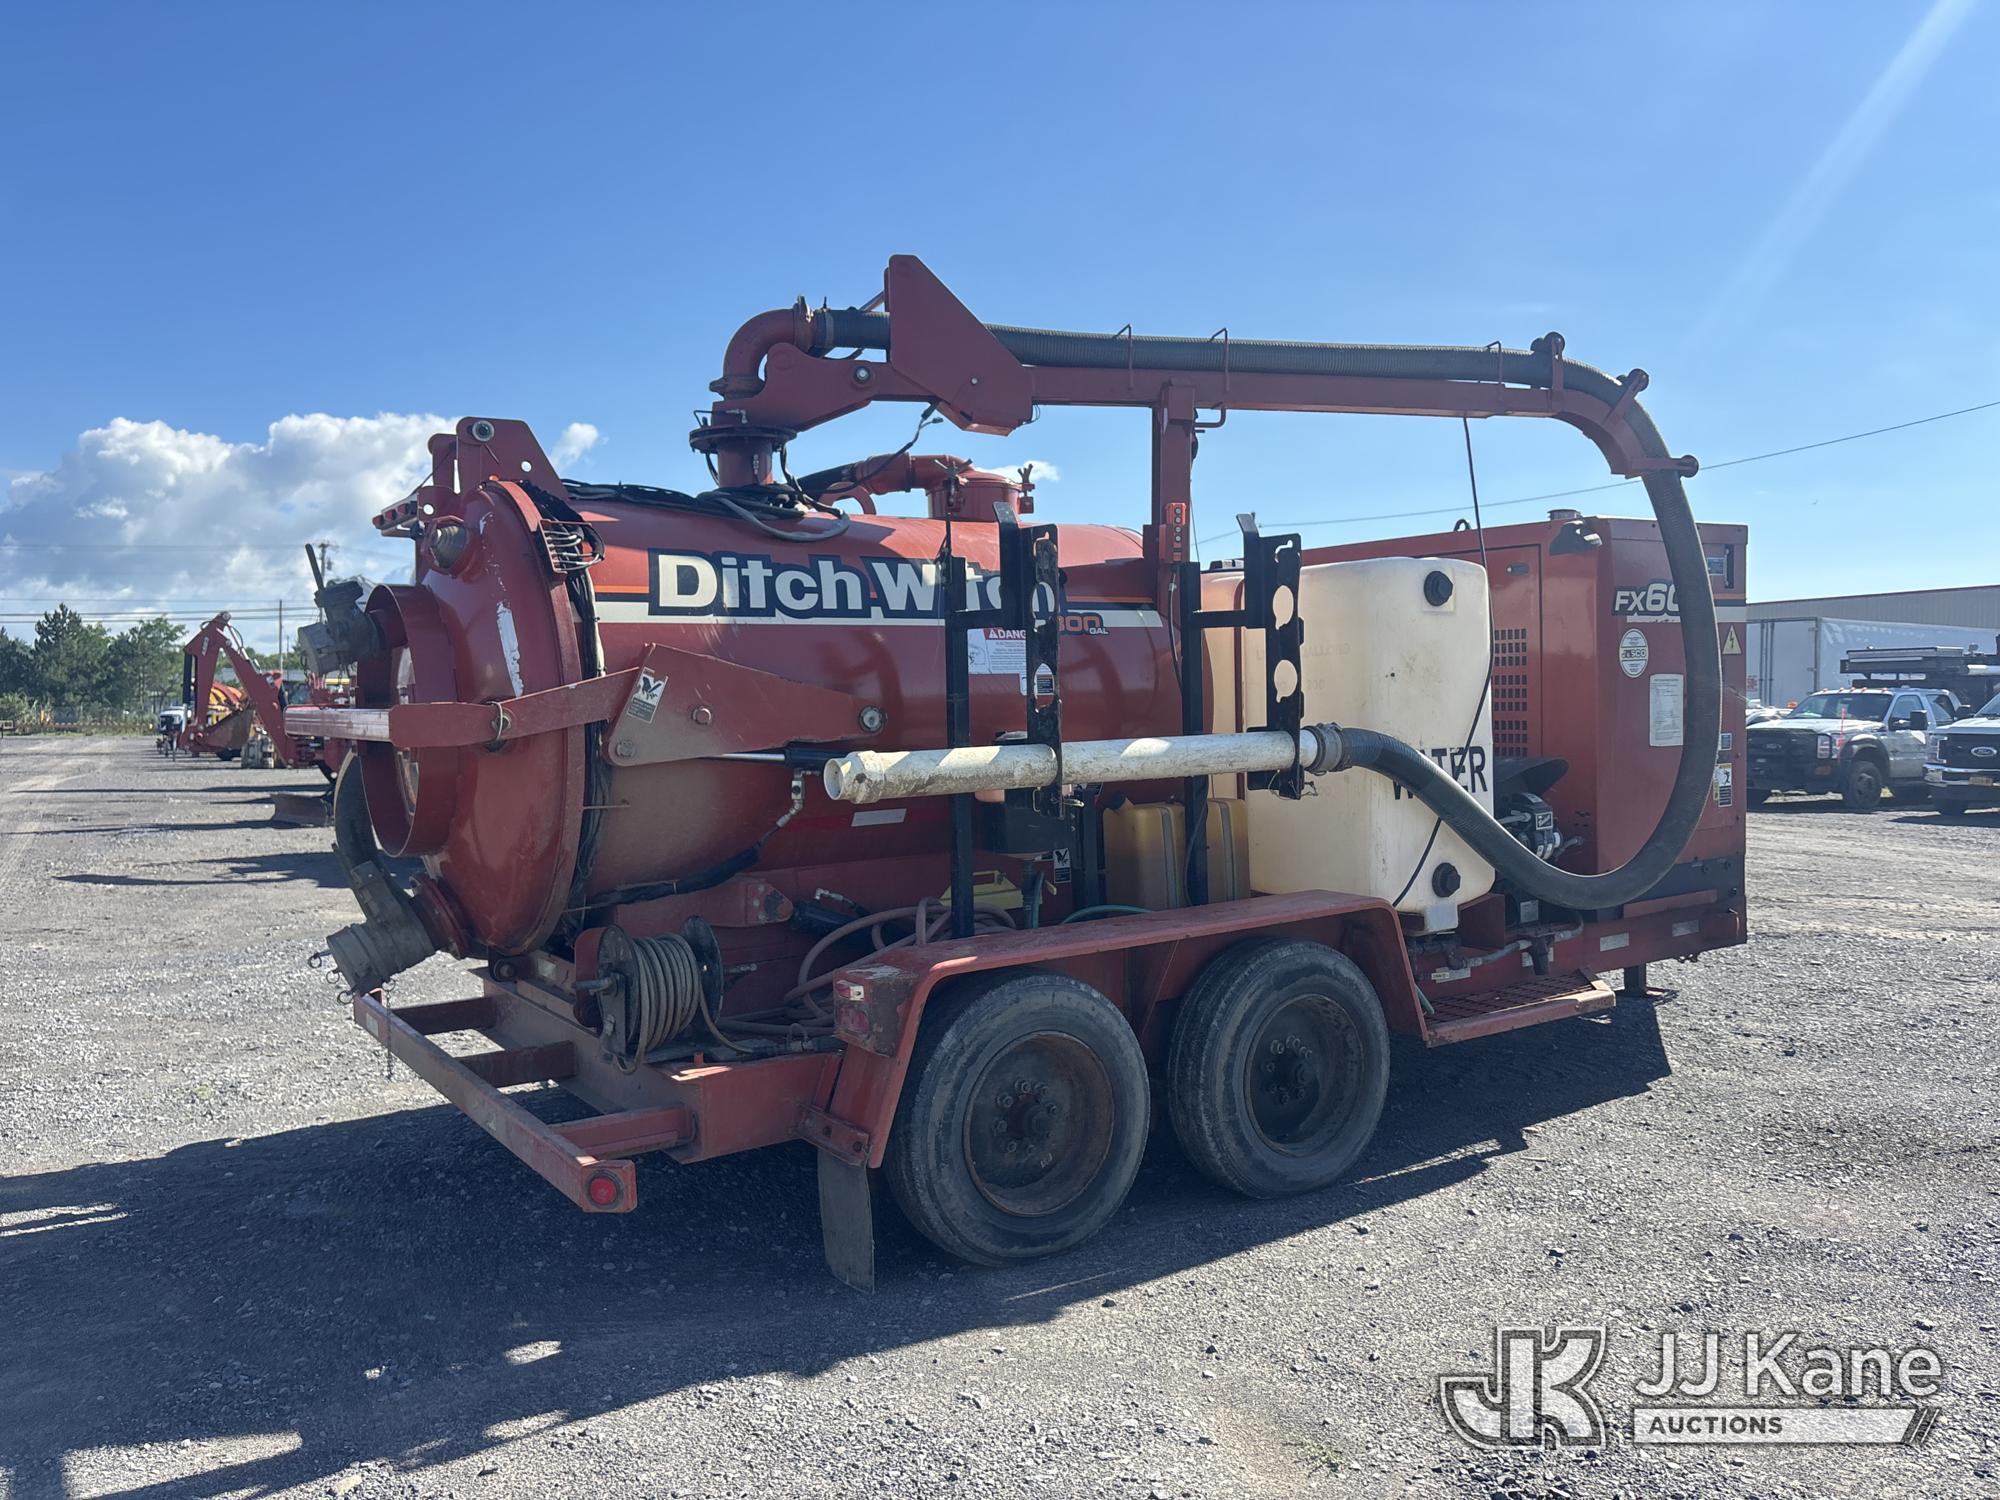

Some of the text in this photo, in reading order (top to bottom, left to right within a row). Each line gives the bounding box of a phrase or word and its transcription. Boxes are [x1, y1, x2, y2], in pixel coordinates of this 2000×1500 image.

[658, 554, 863, 610] Ditch
[998, 629, 1026, 639] DANG
[1089, 627, 1109, 635] GAL
